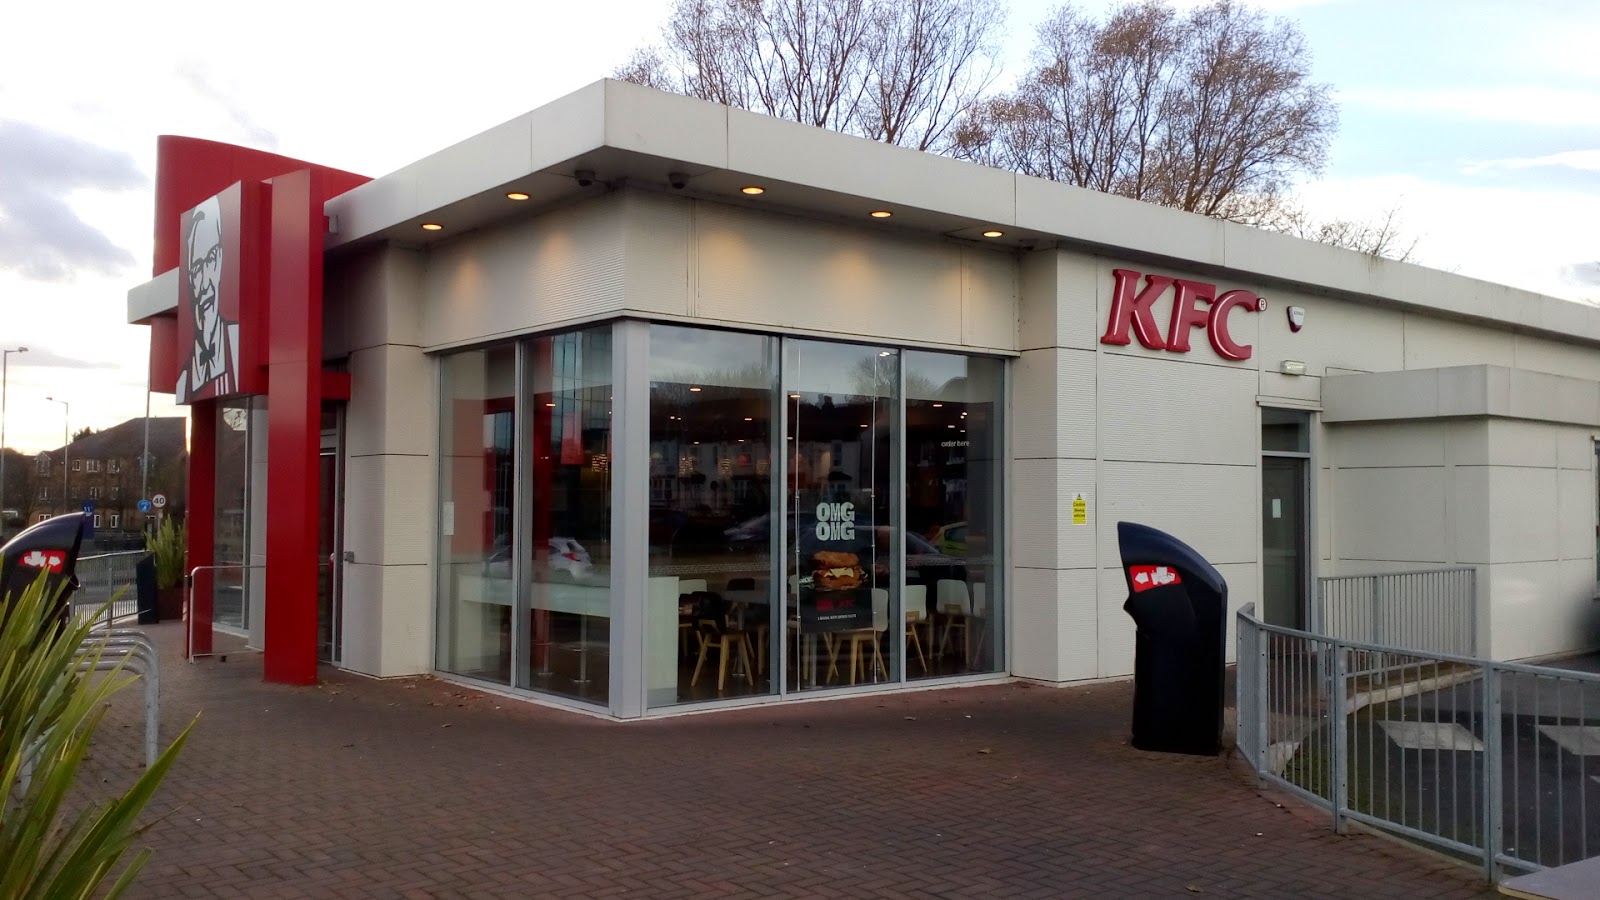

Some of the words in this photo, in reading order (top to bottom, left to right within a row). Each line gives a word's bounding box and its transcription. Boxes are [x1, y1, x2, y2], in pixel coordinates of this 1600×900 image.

[1100, 269, 1257, 361] KFC
[816, 502, 855, 521] OMG
[815, 521, 856, 541] OMG
